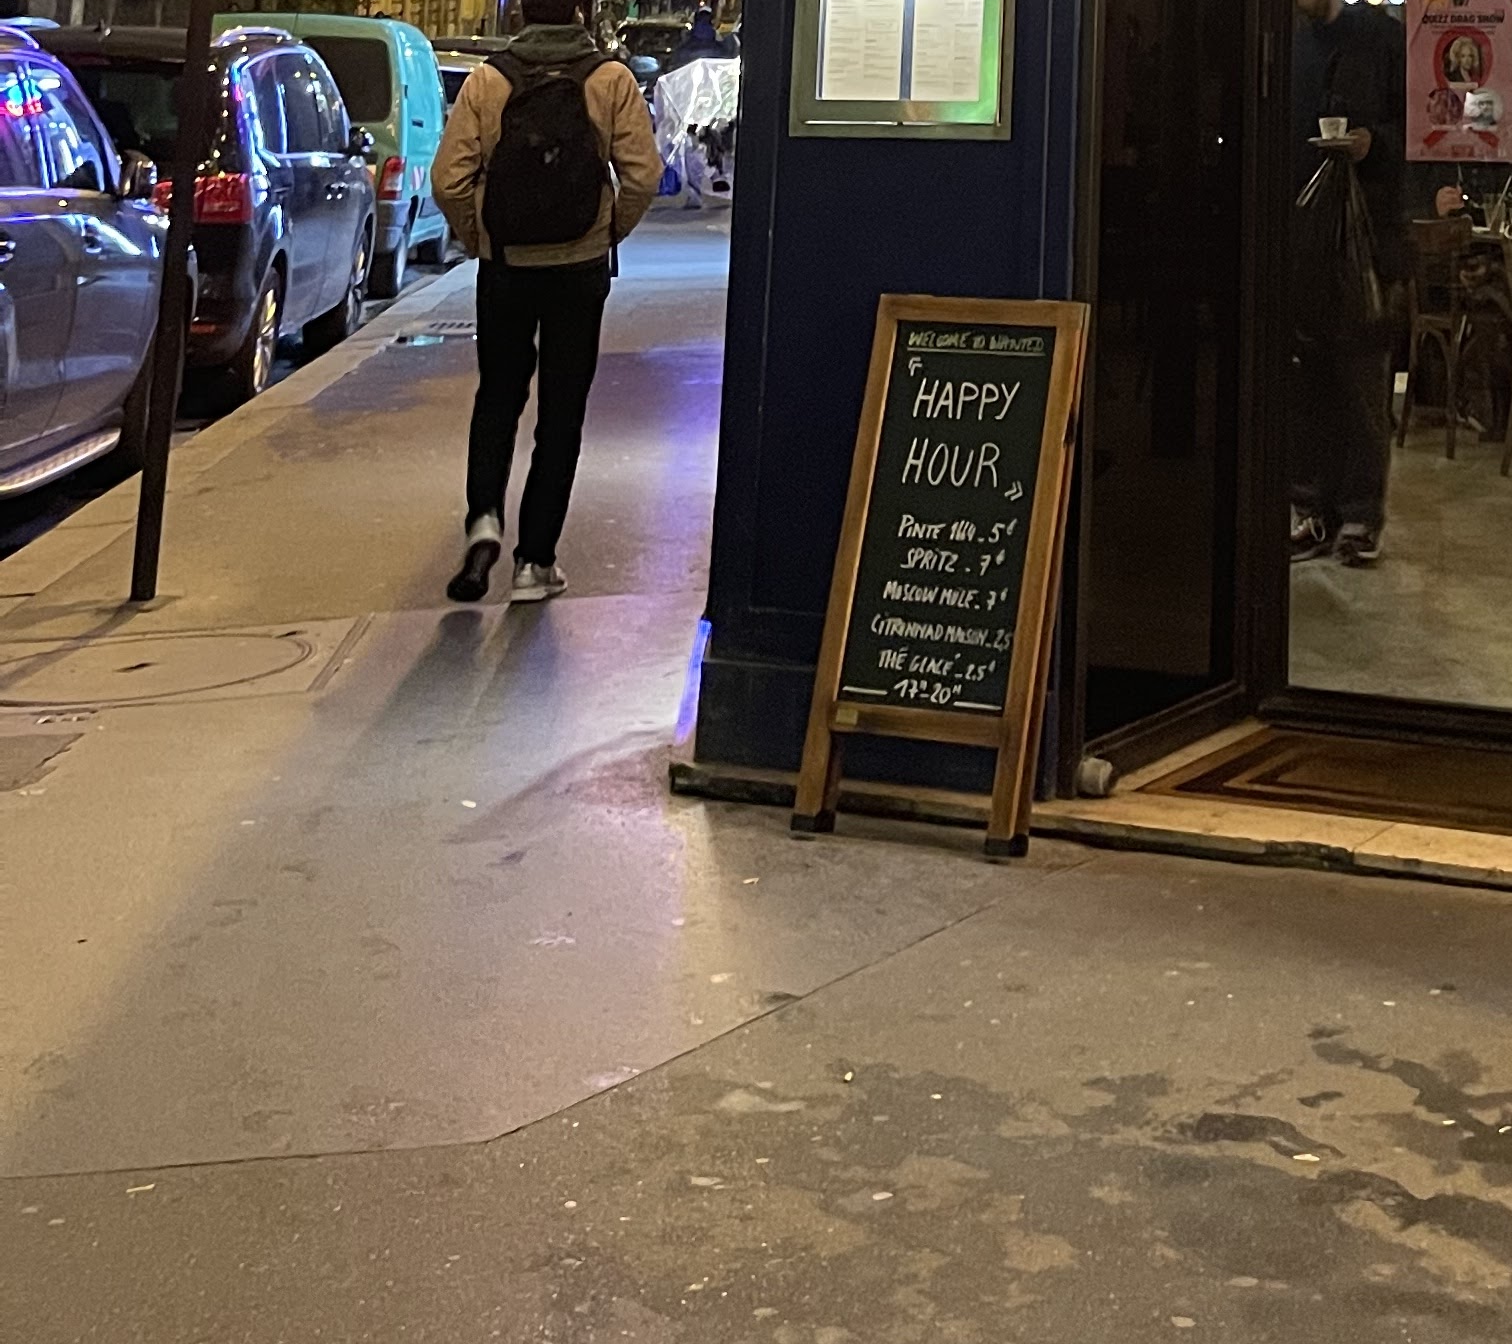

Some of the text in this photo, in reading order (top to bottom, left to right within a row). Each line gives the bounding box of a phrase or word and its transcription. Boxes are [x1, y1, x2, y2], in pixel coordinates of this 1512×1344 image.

[909, 331, 971, 348] WELCOME
[912, 378, 1020, 420] HAPPY
[901, 437, 1001, 488] HOUR
